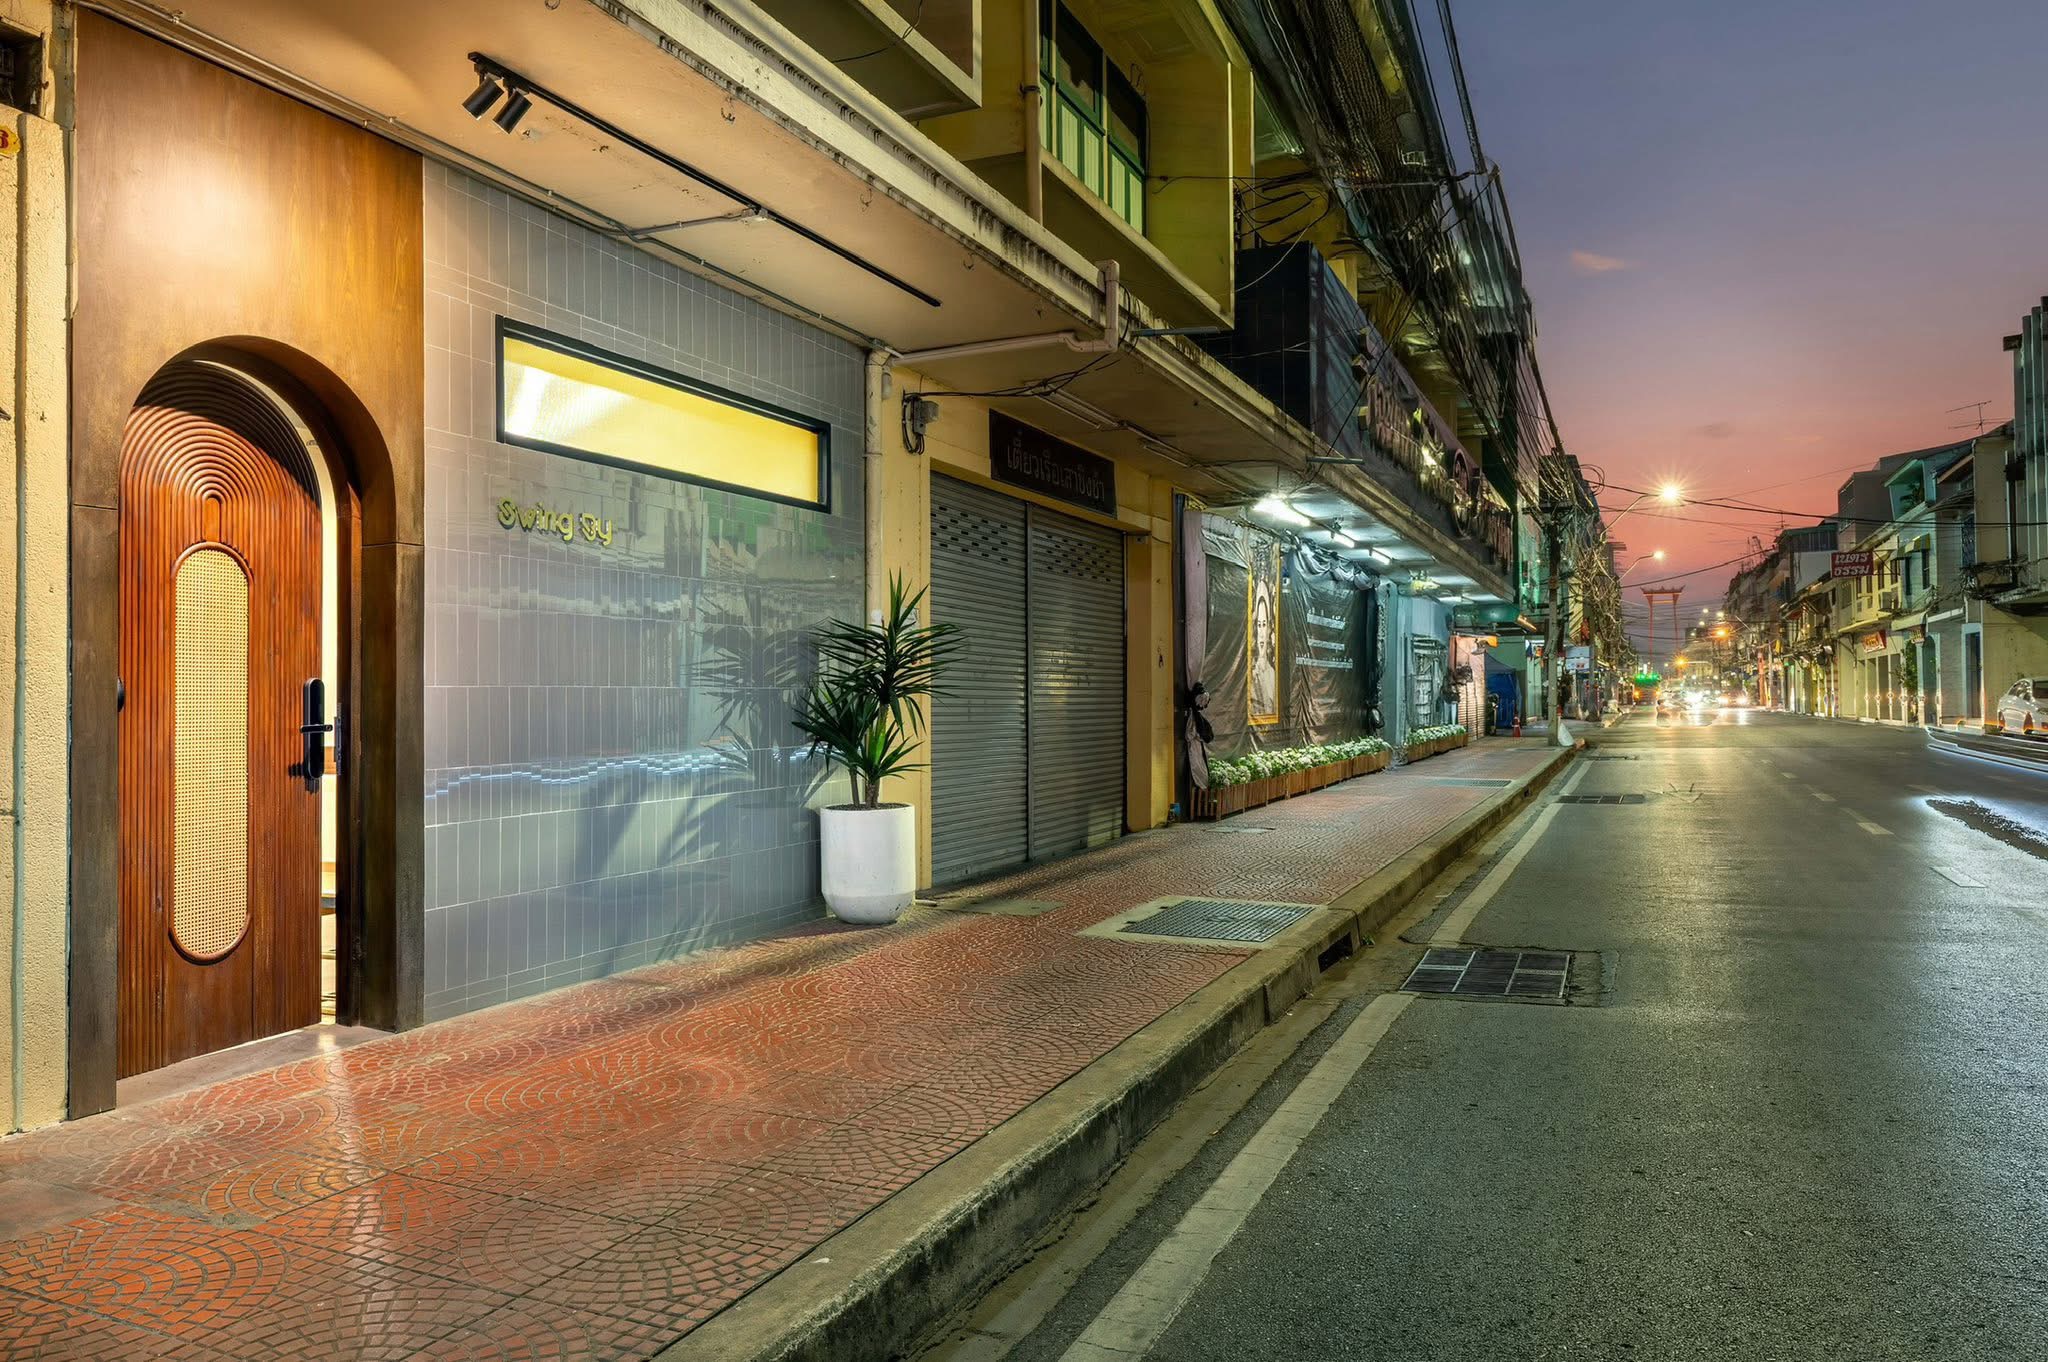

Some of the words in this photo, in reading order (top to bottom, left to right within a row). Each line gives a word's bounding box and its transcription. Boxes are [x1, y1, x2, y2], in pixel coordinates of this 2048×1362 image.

[498, 498, 574, 543] Swing
[579, 512, 612, 547] By
[1834, 565, 1870, 577] ธรรม
